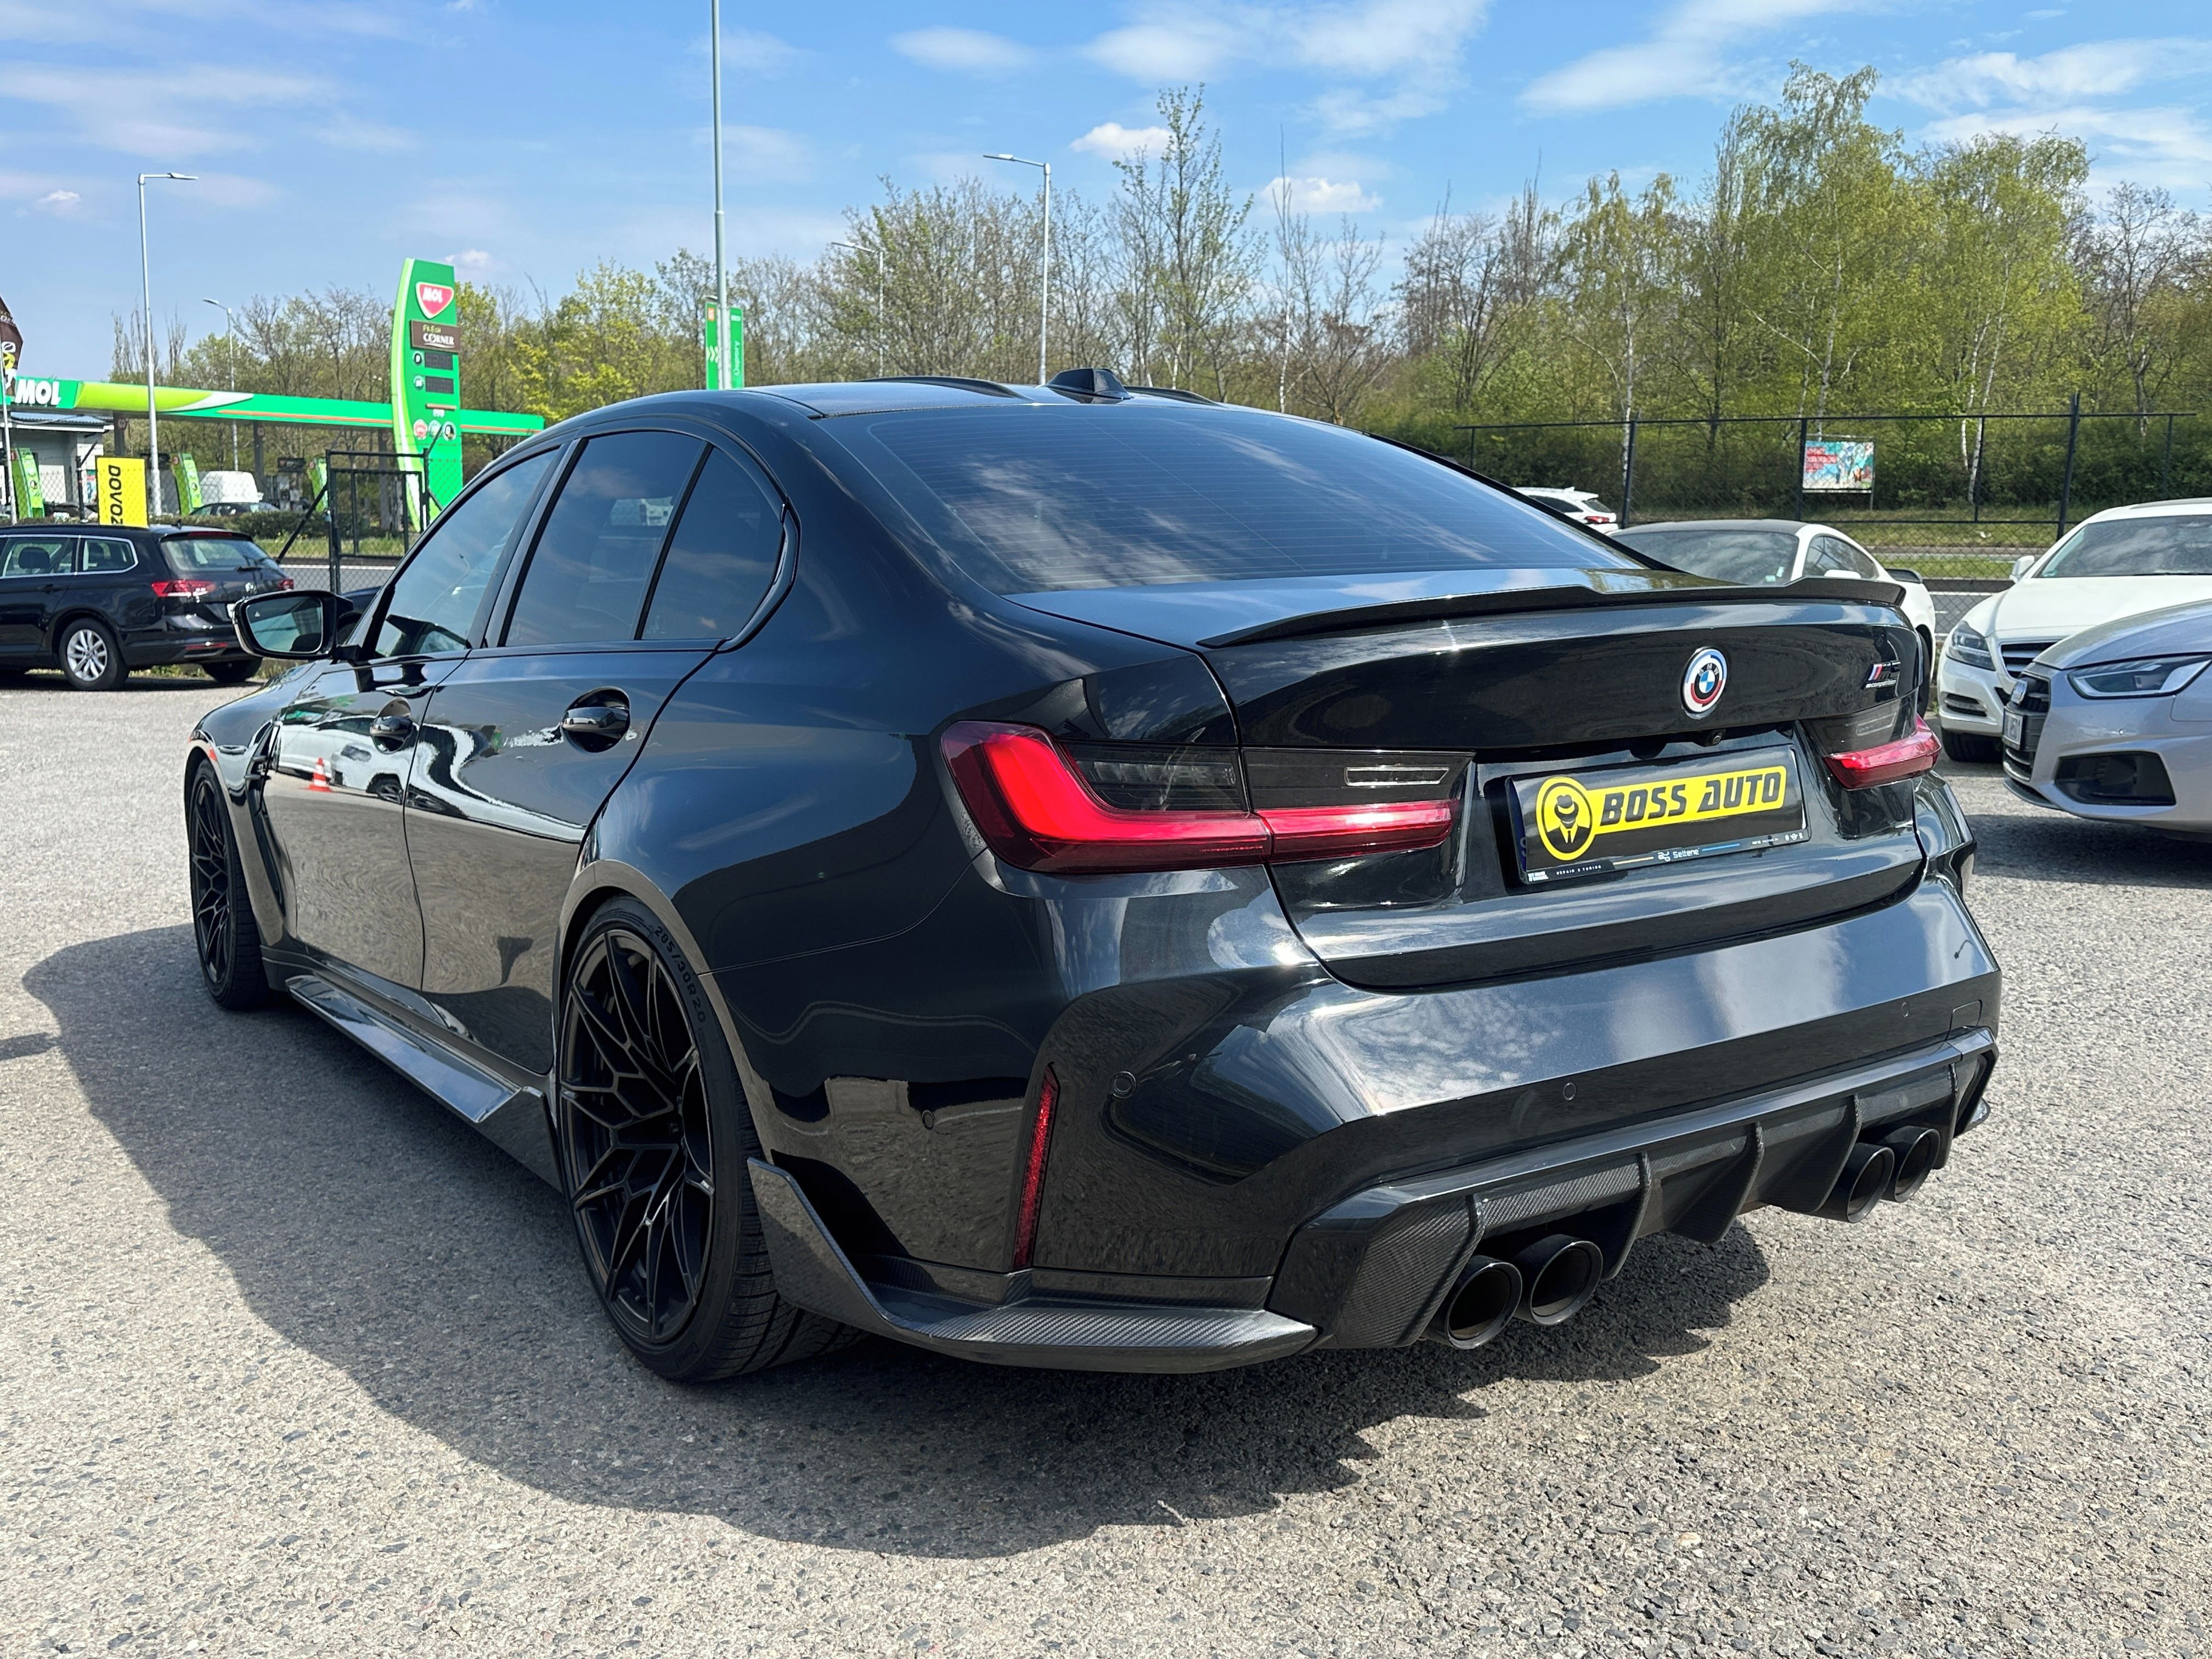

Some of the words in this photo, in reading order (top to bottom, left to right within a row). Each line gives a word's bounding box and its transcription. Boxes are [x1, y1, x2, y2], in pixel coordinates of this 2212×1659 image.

[422, 286, 443, 303] MOL
[15, 379, 61, 405] MOL
[1699, 663, 1719, 677] BMW
[1600, 784, 1687, 827] BOSS
[1697, 772, 1781, 813] AUTO
